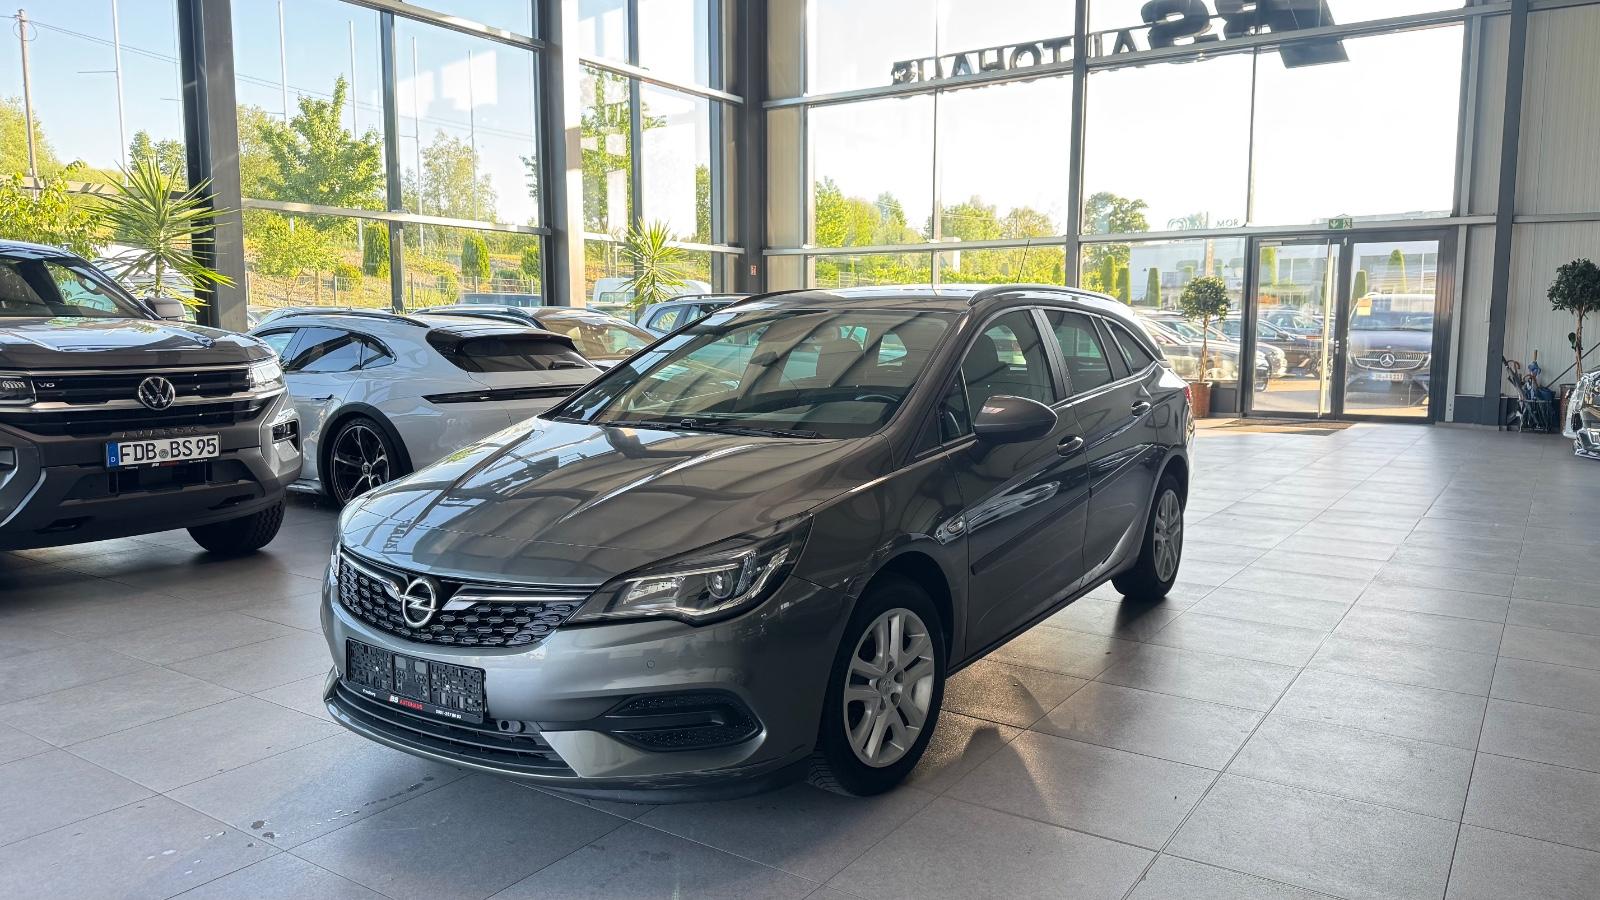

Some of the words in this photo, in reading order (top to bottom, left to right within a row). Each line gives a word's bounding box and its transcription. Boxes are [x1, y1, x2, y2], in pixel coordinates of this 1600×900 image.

[119, 442, 157, 463] FDB
[170, 439, 193, 459] BS
[196, 438, 217, 456] 95
